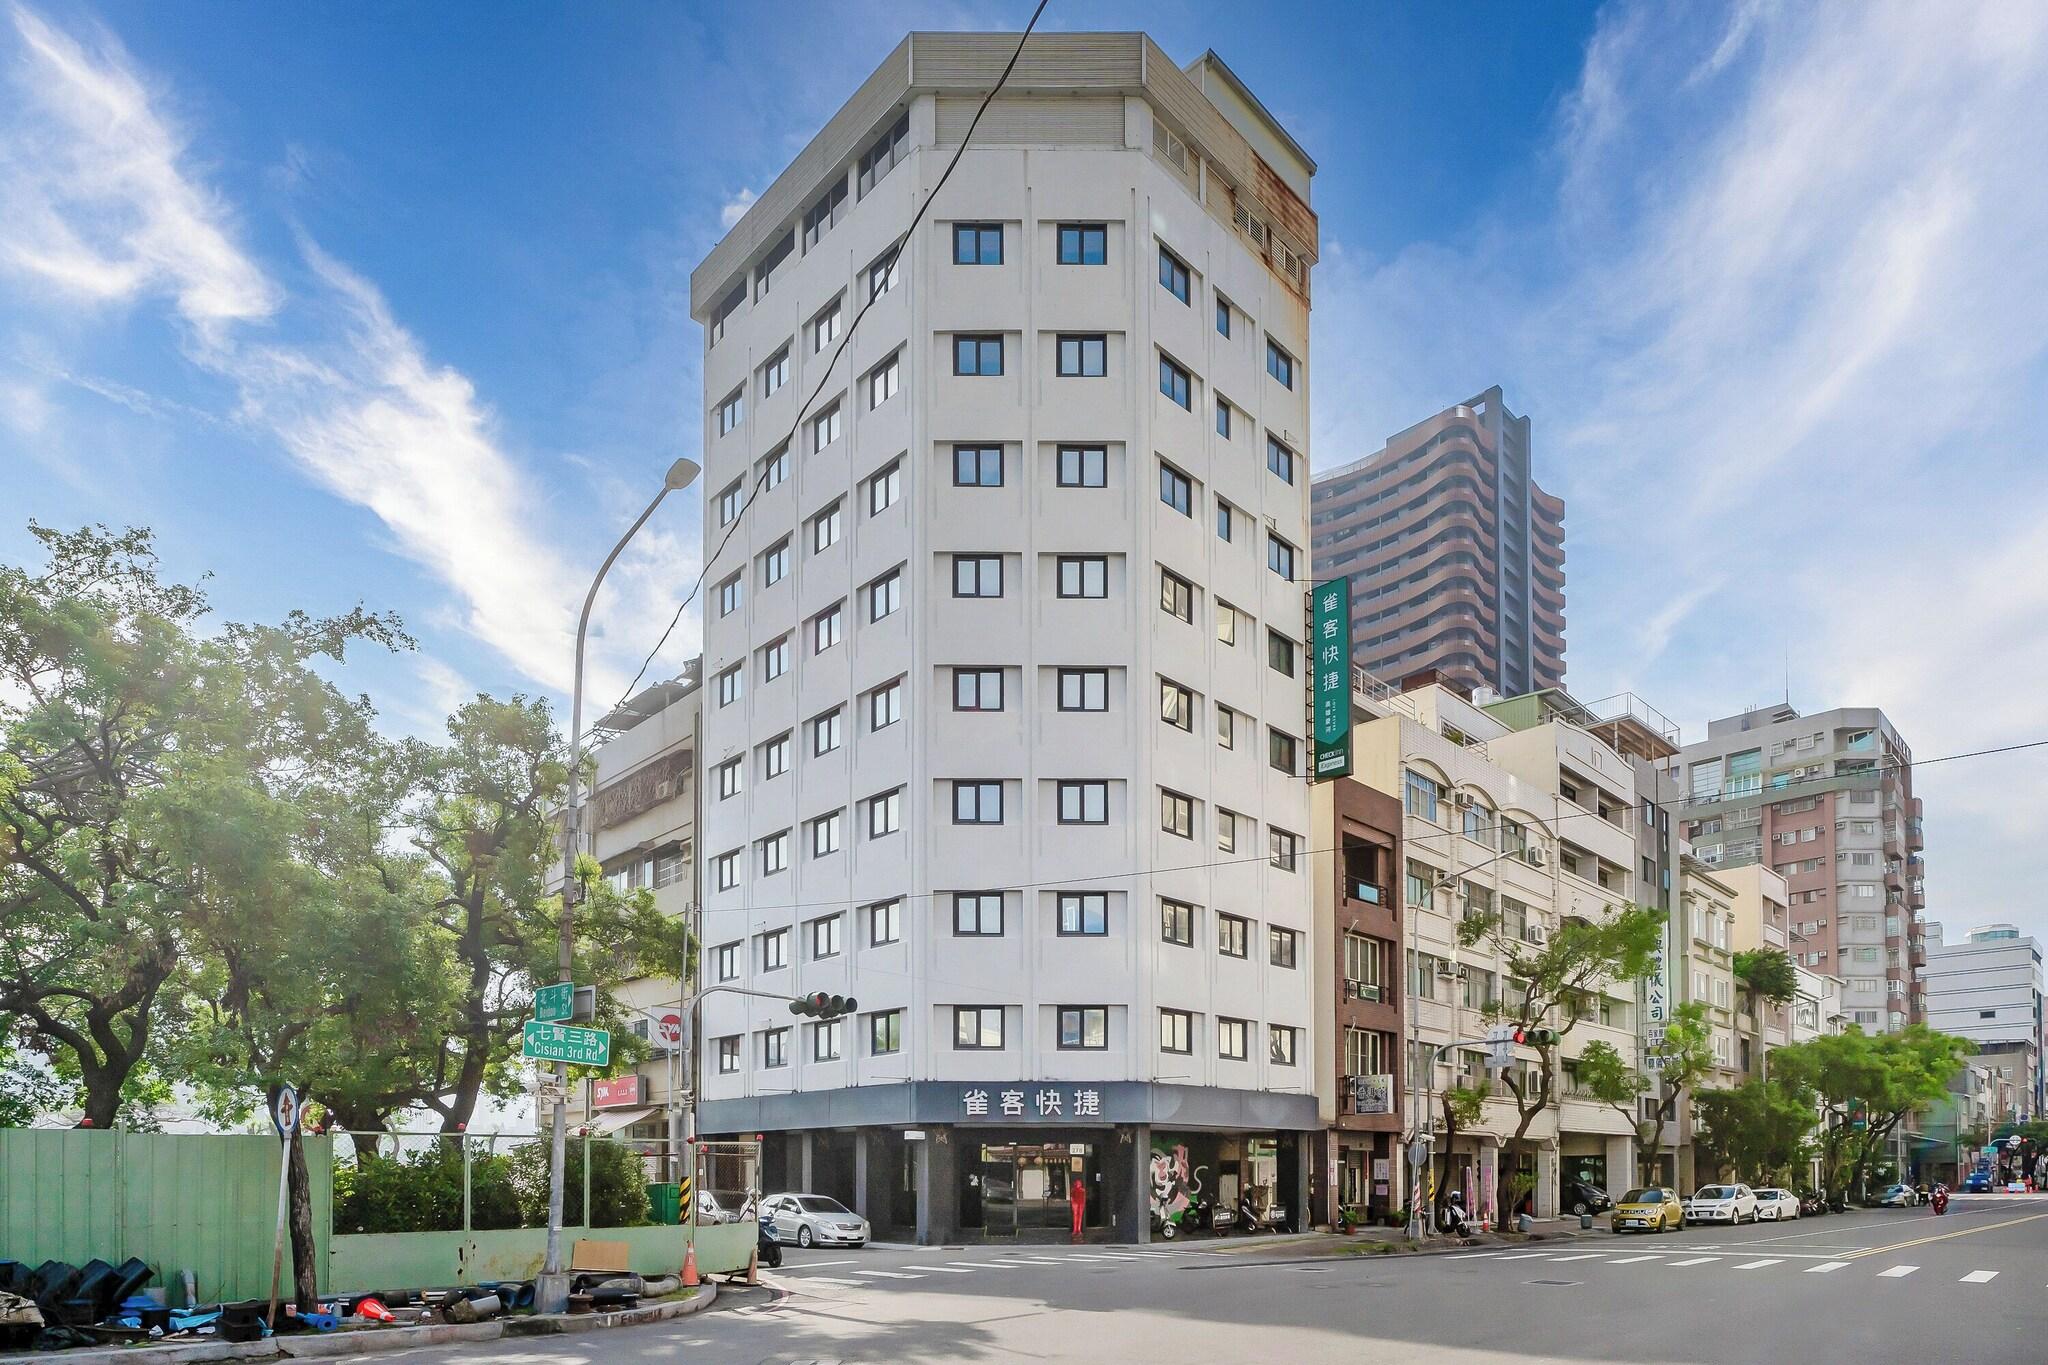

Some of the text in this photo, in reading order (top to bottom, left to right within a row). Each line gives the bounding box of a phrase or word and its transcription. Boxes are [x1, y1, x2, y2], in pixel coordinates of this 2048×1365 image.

[1322, 592, 1340, 692] 雀客快捷
[536, 1025, 598, 1047] 七賢三路
[534, 1041, 600, 1061] Cisian 3rd Rd.
[963, 1089, 1100, 1116] 雀客快捷
